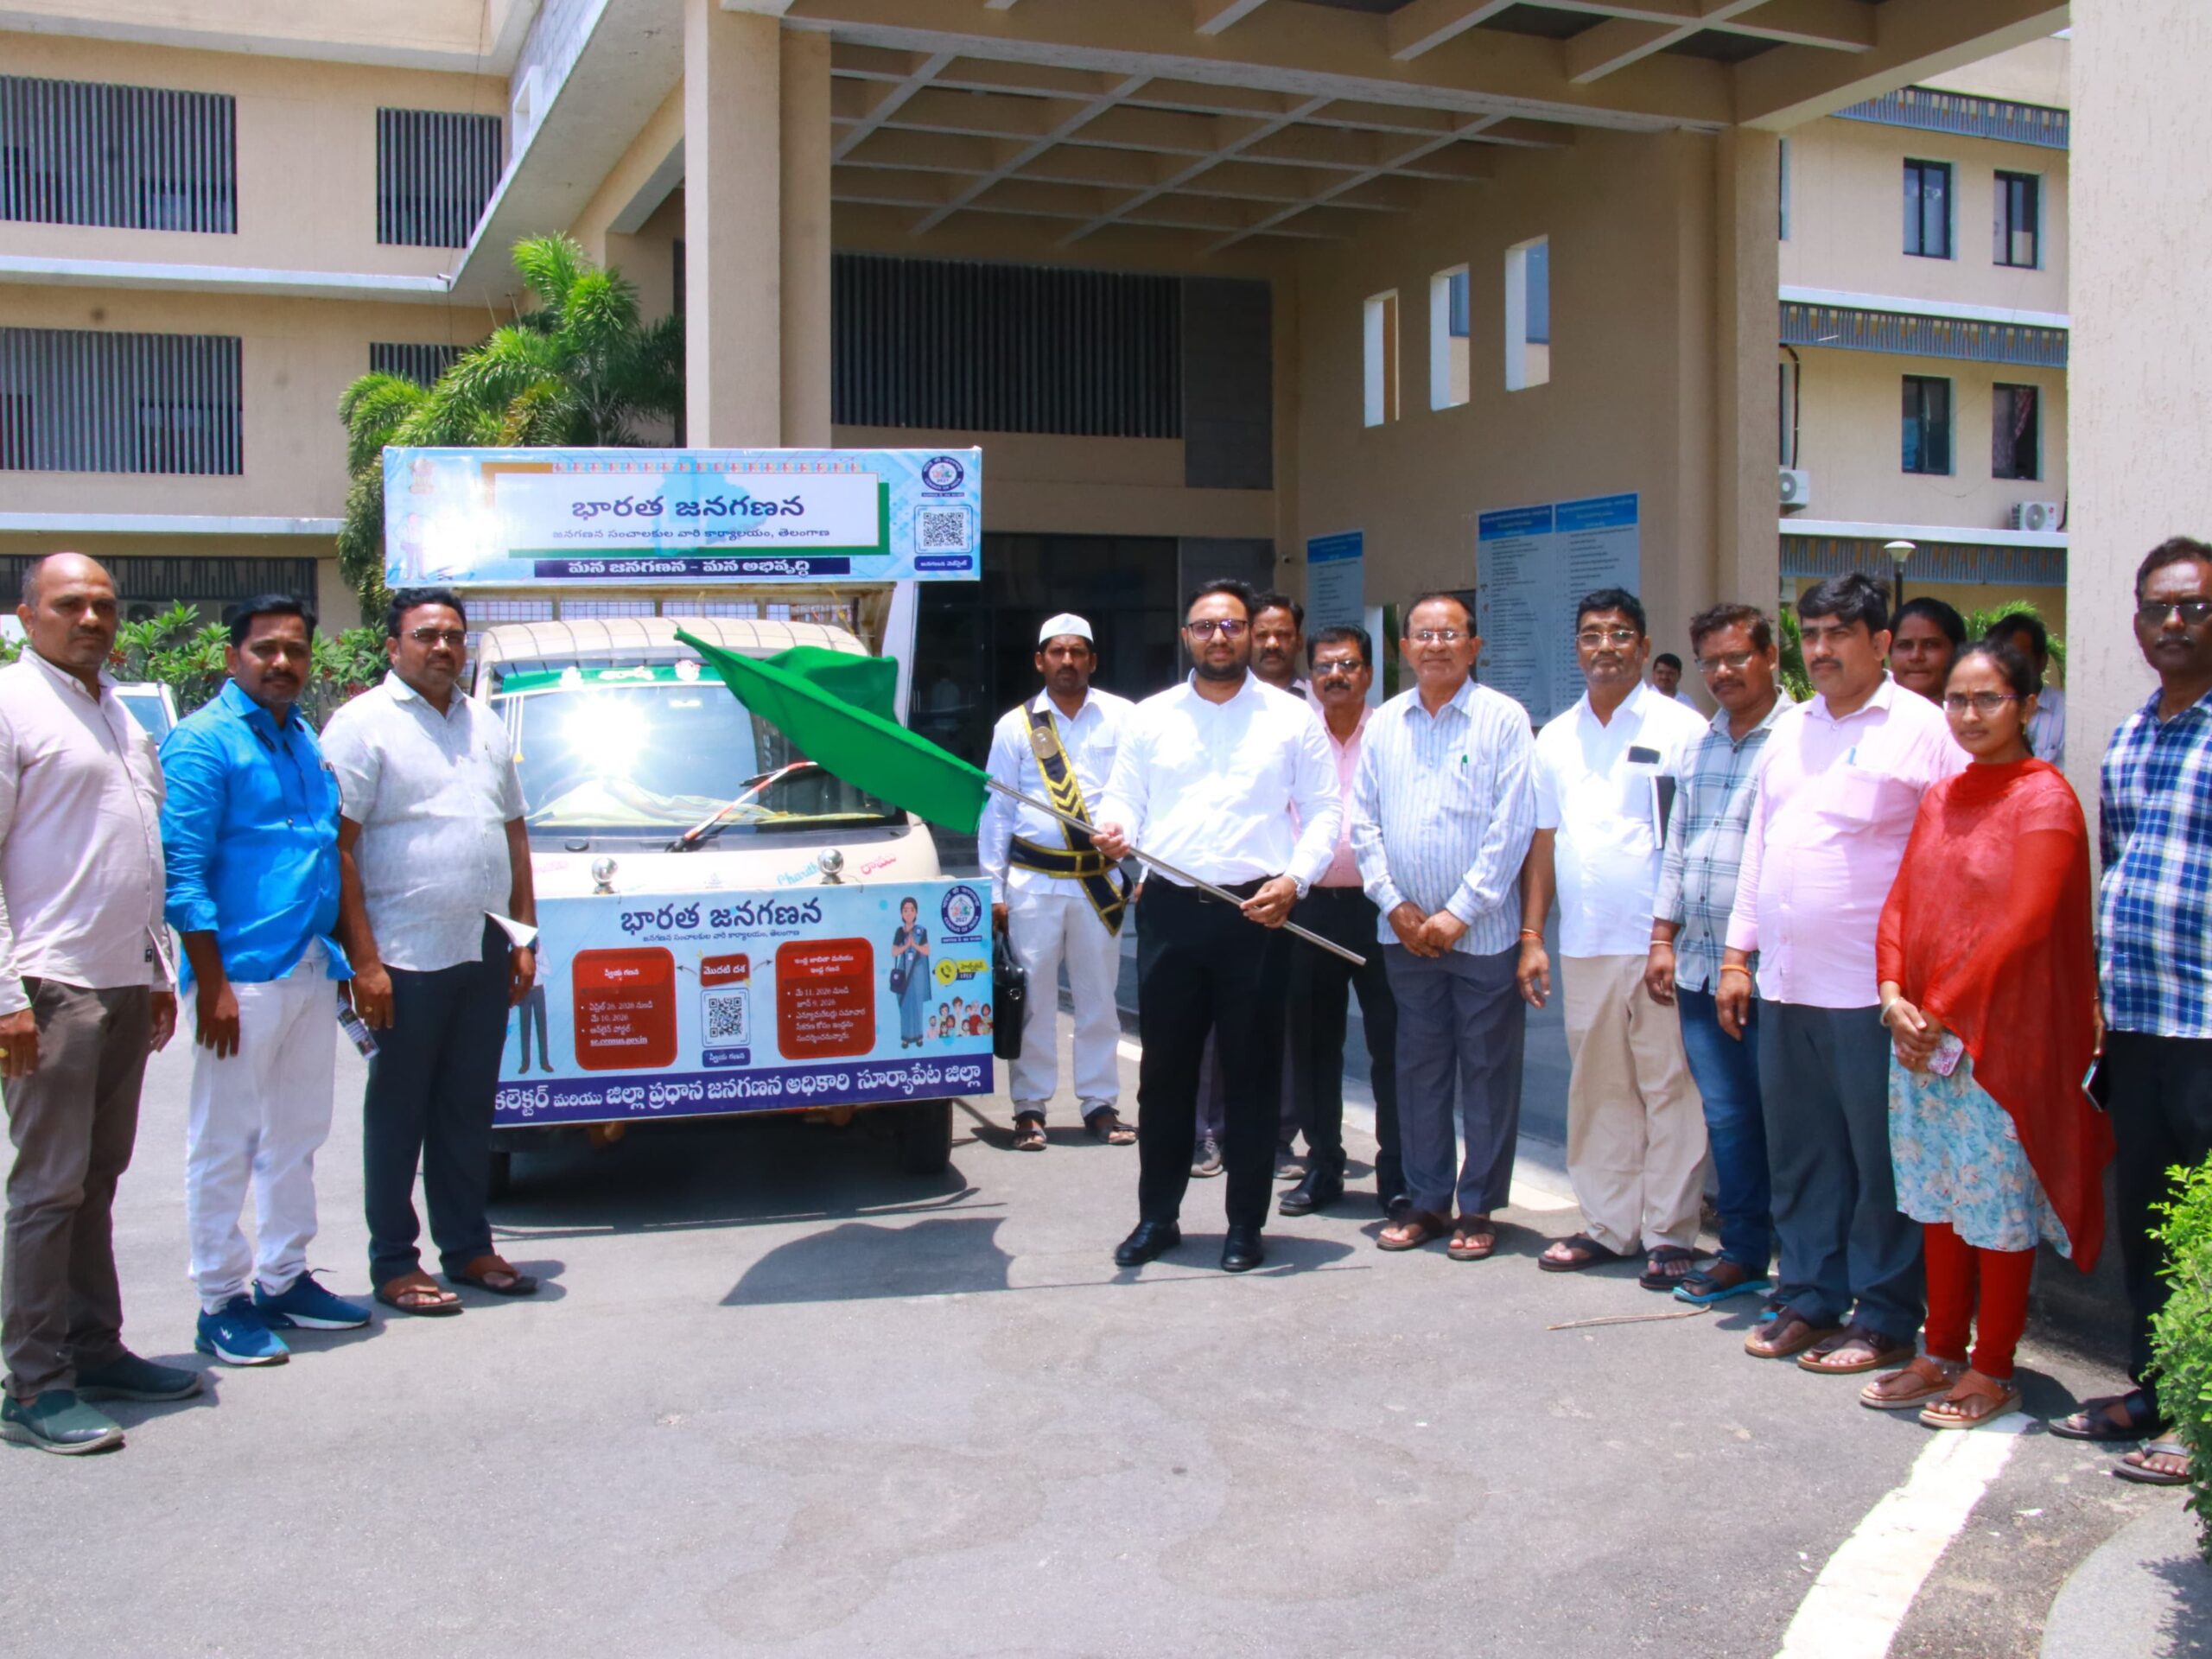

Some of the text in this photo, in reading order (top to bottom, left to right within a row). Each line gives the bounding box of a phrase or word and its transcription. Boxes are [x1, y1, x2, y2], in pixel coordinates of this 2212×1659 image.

[571, 495, 805, 521] భారత జనగణన
[553, 530, 604, 539] జనగణన
[607, 529, 674, 539] సంచాలకుల
[677, 529, 701, 538] వారి
[779, 529, 830, 537] తెలంగాణ
[569, 560, 606, 574] మన
[610, 559, 687, 574] జనగణన
[702, 559, 739, 573] మన
[620, 897, 823, 936] భారత జనగణన
[944, 917, 961, 932] CENSUS
[703, 963, 746, 976] మొదటి దశ
[494, 1062, 982, 1117] కలెక్టర్ మరియు జిల్లా ప్రధాన జనగణన అధికారి సూర్యాపేట జిల్లా
